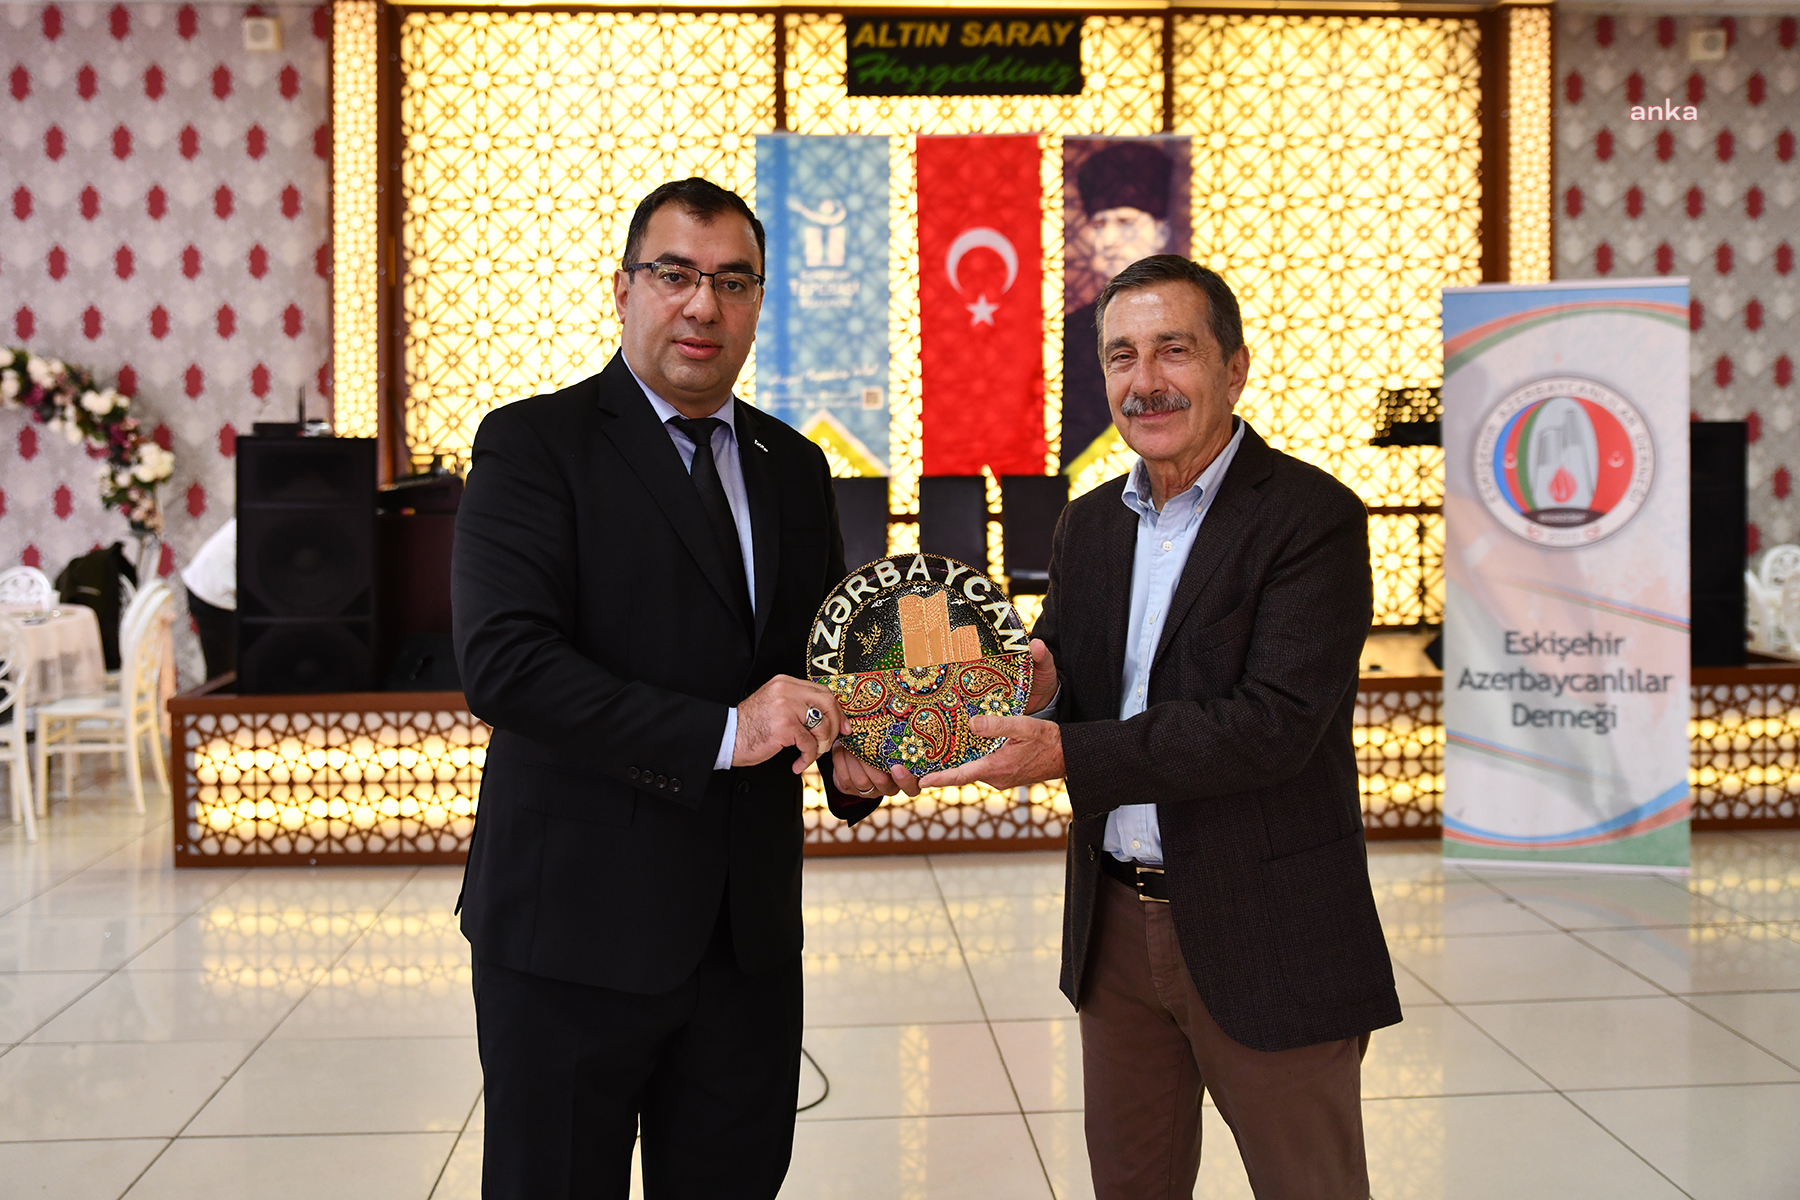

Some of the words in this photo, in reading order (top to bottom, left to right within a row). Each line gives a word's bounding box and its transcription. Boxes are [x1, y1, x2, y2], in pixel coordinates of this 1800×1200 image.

[852, 21, 950, 48] ALTIN
[960, 20, 1076, 47] SARAY
[811, 554, 1030, 676] AZƏRBAYCAN
[1504, 630, 1625, 662] Eskişehir
[1458, 667, 1674, 697] Azerbaycanlılar
[1511, 703, 1618, 735] Derneği
